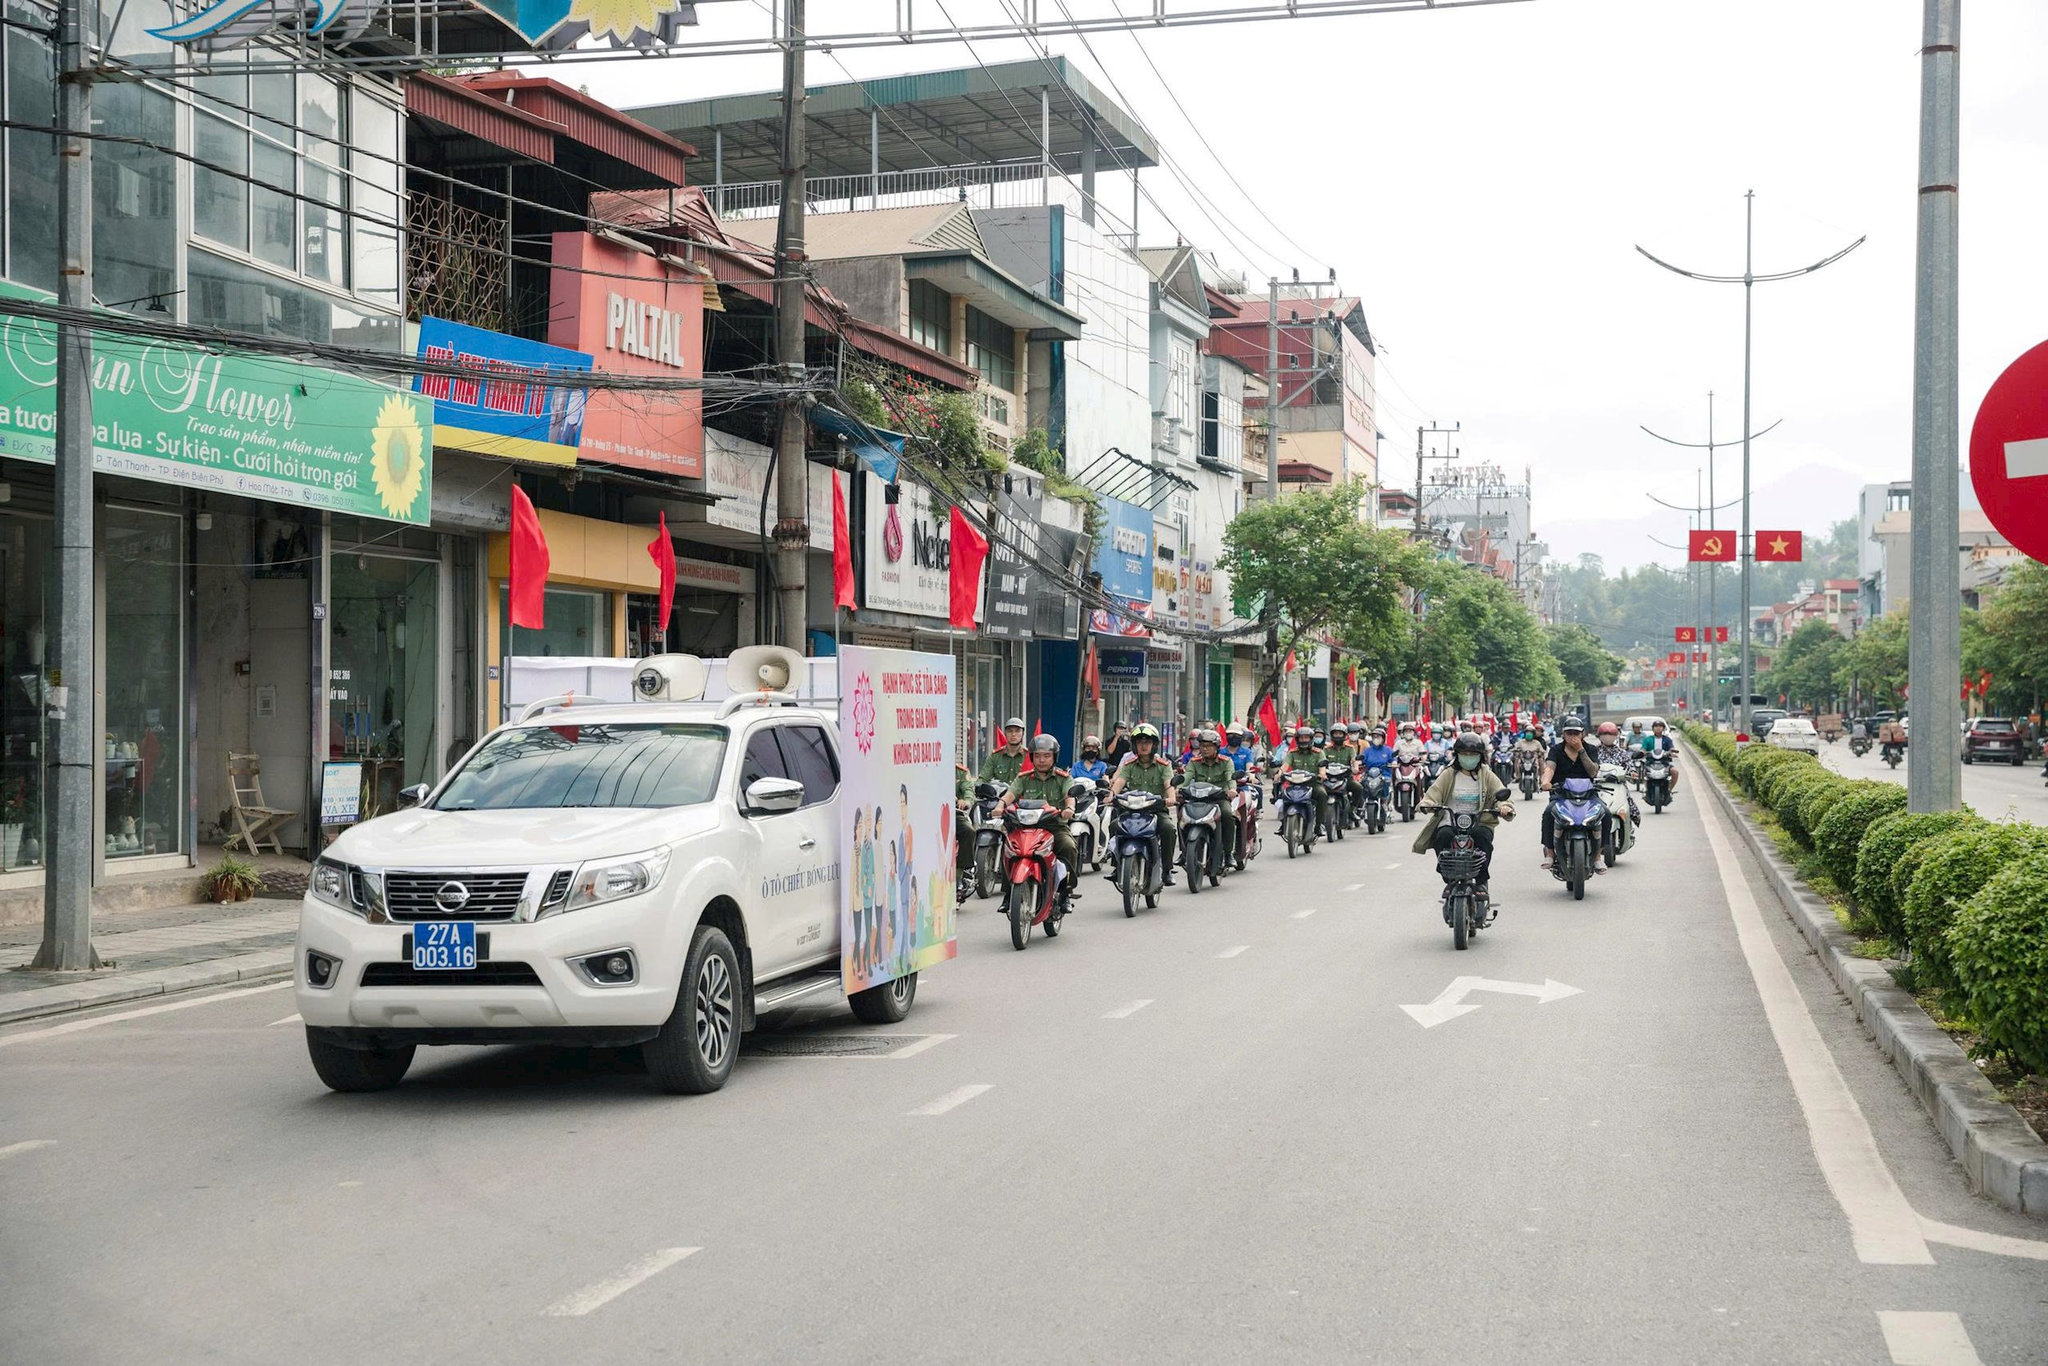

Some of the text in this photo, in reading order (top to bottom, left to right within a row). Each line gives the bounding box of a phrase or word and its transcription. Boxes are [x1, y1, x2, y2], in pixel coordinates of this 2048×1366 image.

[140, 339, 297, 431] Flower
[186, 415, 217, 435] Trao
[218, 424, 240, 441] sản
[282, 438, 312, 456] nhận
[314, 444, 342, 462] niềm
[343, 452, 364, 465] tin!
[113, 421, 143, 451] lụa
[156, 432, 181, 460] Sự
[183, 435, 221, 465] kiện
[233, 447, 271, 473] Cưới
[274, 453, 299, 478] hỏi
[301, 461, 332, 486] trọn
[333, 469, 358, 491] gói
[882, 672, 899, 699] HẠNH
[899, 668, 914, 694] PHÚC
[934, 671, 948, 695] SÁNG
[896, 703, 938, 730] TRONG GIA ĐÌNH
[893, 738, 942, 768] KHÔNG CÓ BẠO LỰC
[341, 803, 356, 814] XE
[761, 875, 769, 899] Ô
[770, 873, 781, 897] TÔ
[782, 865, 806, 894] CHIẾU
[806, 864, 827, 887] BÓNG
[427, 924, 461, 946] 27A
[414, 946, 475, 969] 003.16
